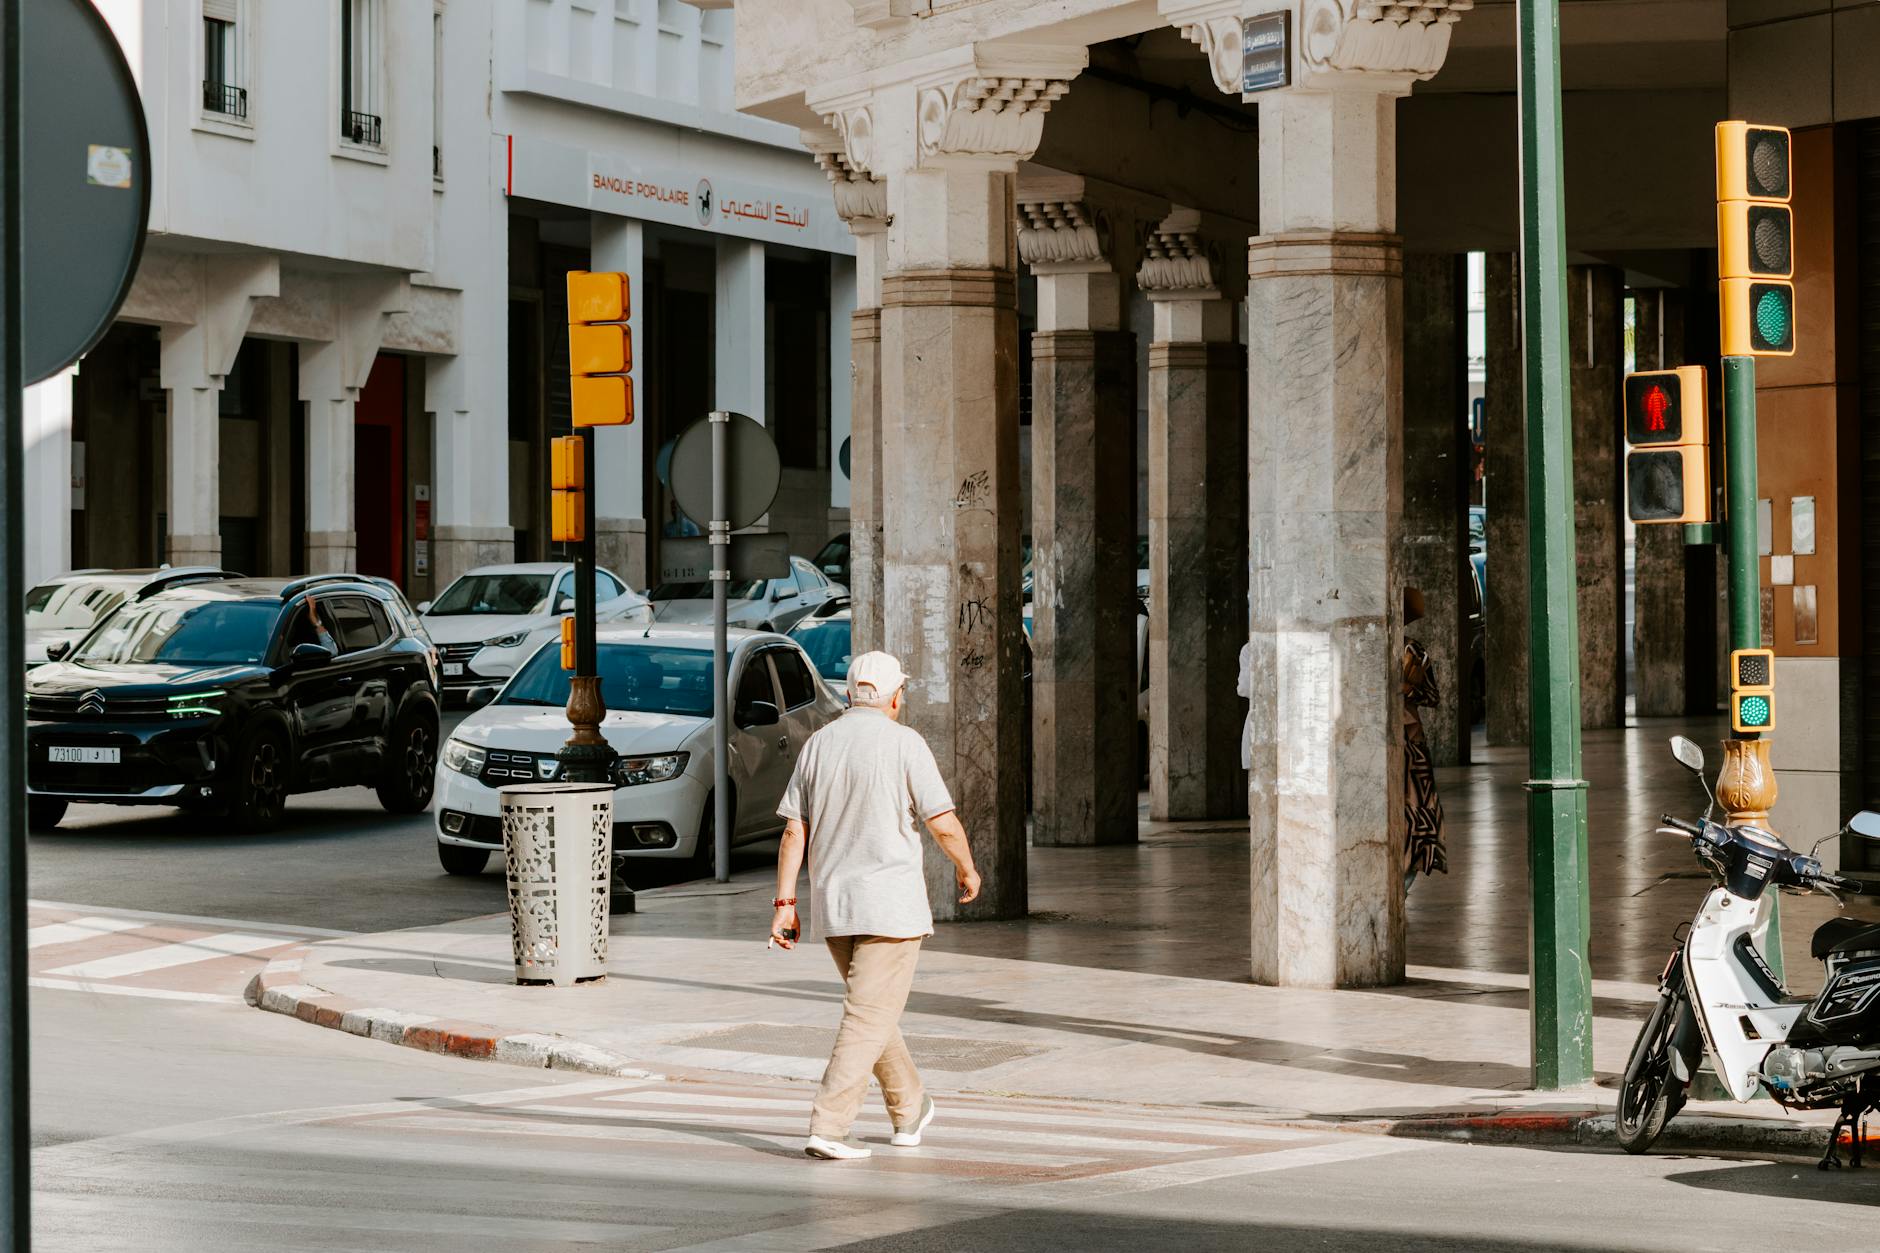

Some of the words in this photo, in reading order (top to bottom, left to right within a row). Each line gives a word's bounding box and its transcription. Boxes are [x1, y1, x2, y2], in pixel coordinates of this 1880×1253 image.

[593, 174, 634, 196] BANQUE
[637, 182, 689, 206] POPULAIRE
[720, 199, 772, 222] الشعبي
[775, 204, 809, 232] البنك
[54, 748, 82, 761] 73100
